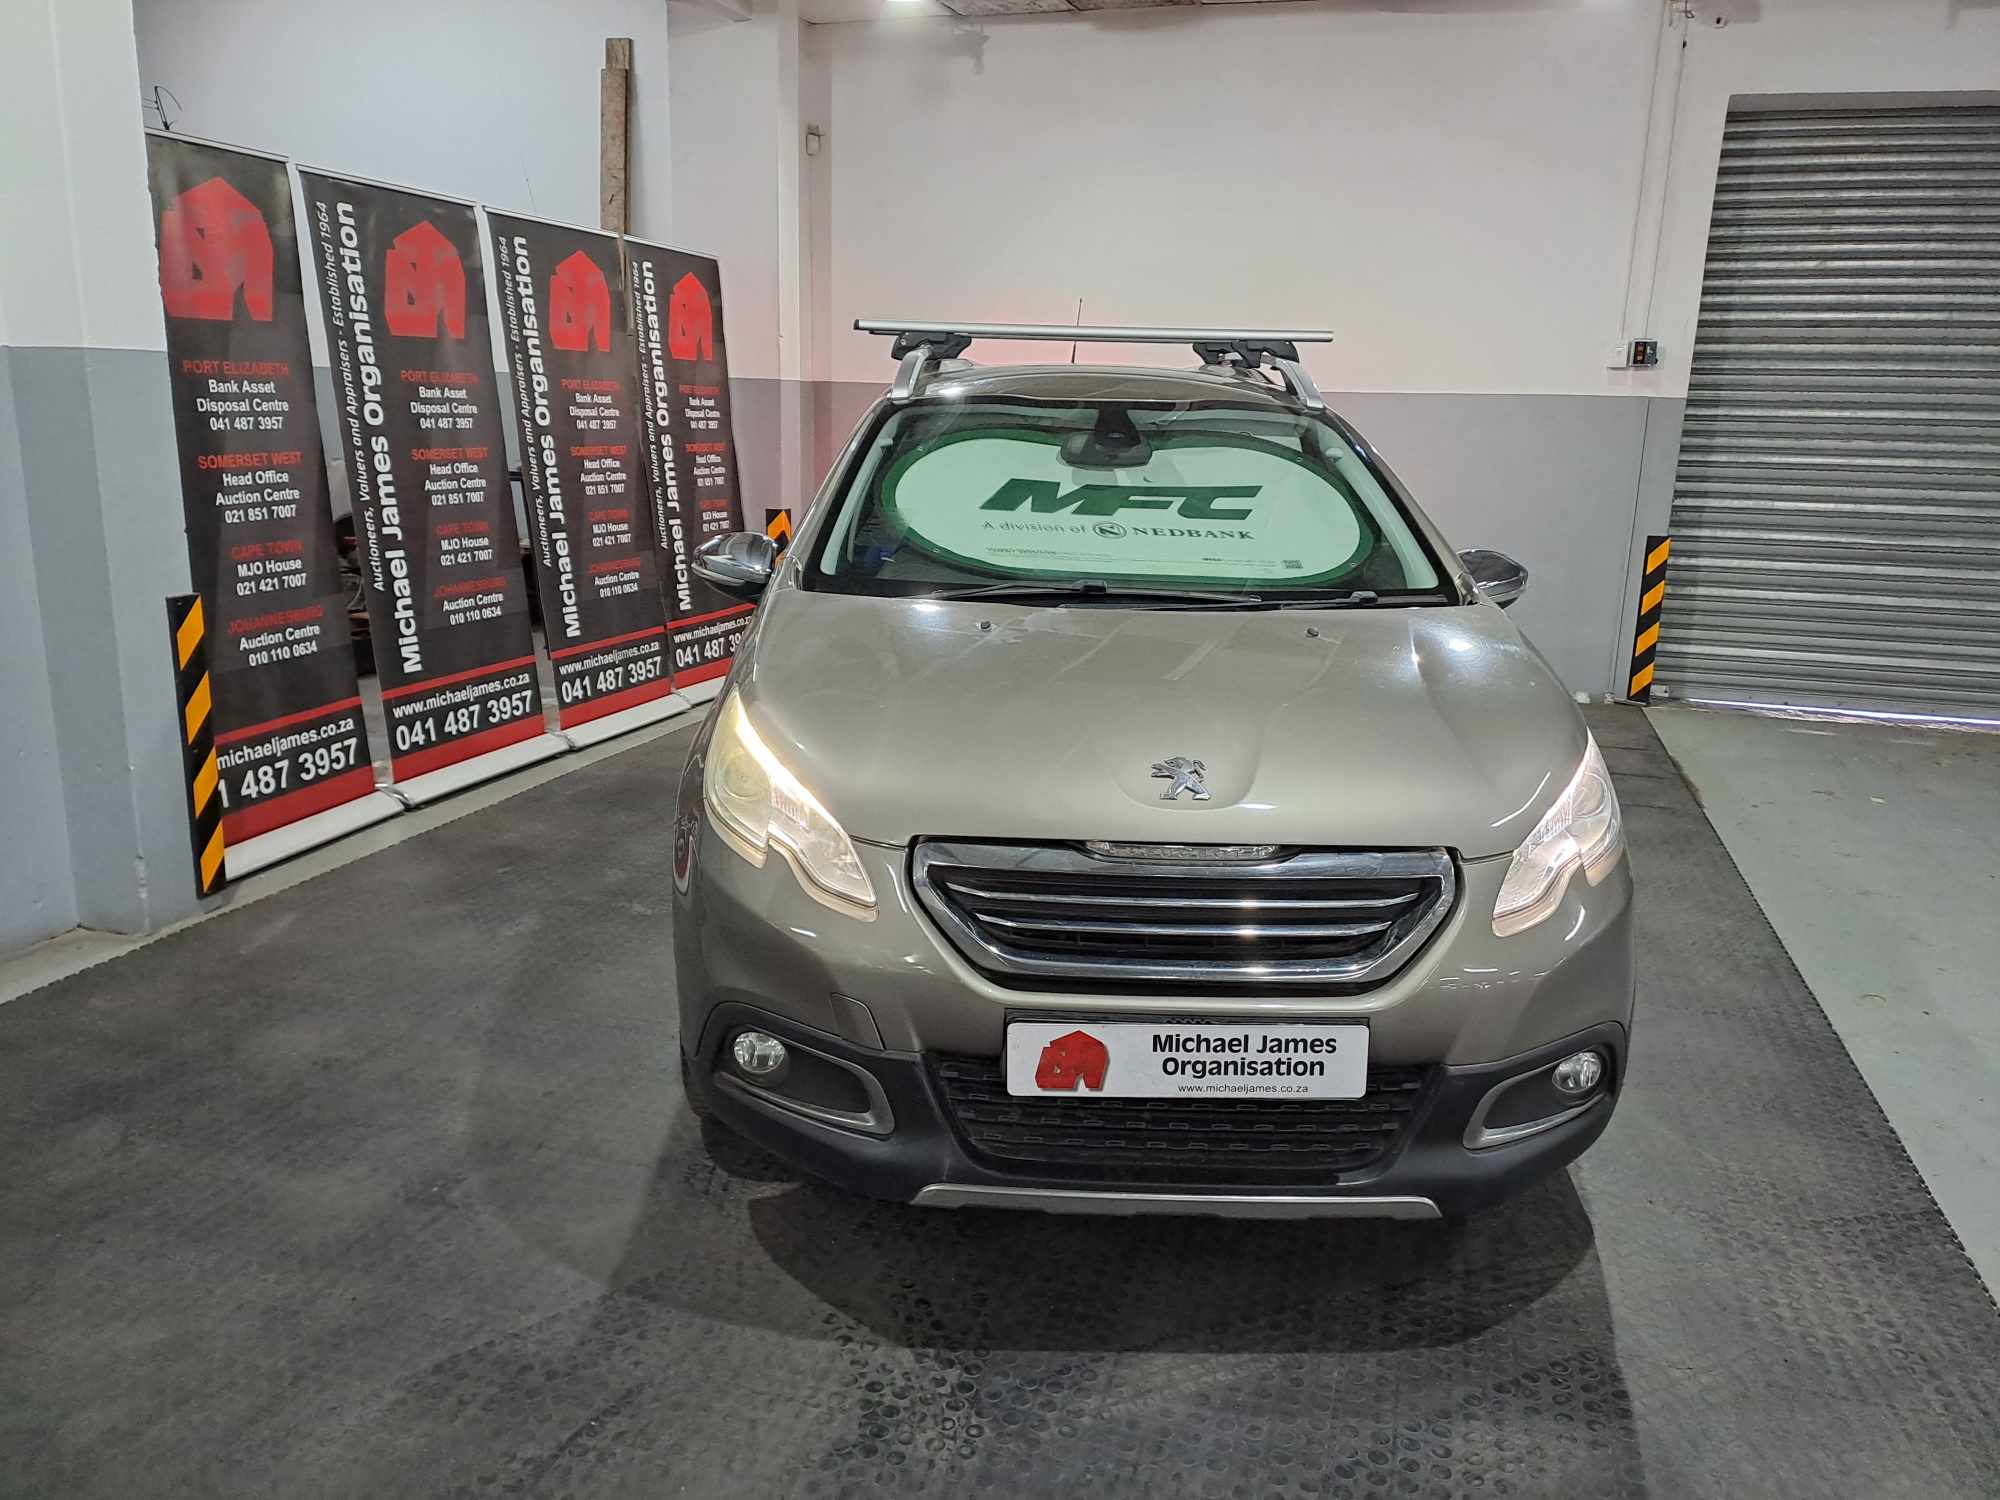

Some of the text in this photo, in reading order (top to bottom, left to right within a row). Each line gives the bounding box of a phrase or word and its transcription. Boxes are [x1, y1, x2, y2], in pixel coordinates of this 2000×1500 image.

[315, 201, 331, 239] 1964
[321, 243, 344, 327] Established
[502, 269, 520, 342] Established
[183, 360, 219, 374] PORT
[338, 338, 359, 416] Appraisers
[208, 379, 276, 394] Bank Asset
[419, 386, 467, 399] Bank Asset
[514, 352, 532, 417] Appraisers
[196, 398, 289, 414] Disposal Centre
[410, 402, 478, 415] Disposal Centre
[210, 417, 283, 430] 041 487 3957
[347, 417, 363, 445] and
[420, 418, 436, 429] 041
[522, 420, 533, 442] and
[337, 202, 423, 674] Michael James Organisation
[514, 236, 582, 638] Michael James Organisation
[642, 261, 692, 611] Michael James Organisation
[198, 452, 301, 469] SOMERSET WEST
[429, 462, 478, 475] Head Office
[528, 446, 542, 491] Valuers
[222, 470, 289, 486] Head Office
[354, 450, 371, 502] Valuers
[424, 478, 486, 491] Auction Centre
[215, 488, 300, 506] Auction Centre
[432, 491, 484, 506] 021 851 7007
[979, 478, 1264, 520] MFC
[224, 504, 297, 523] 021 851 7007
[607, 523, 629, 532] House
[982, 520, 994, 530] A
[999, 521, 1065, 533] division
[1070, 523, 1087, 534] of
[1132, 527, 1254, 540] NEDBANK
[363, 507, 385, 592] Auctioneers,
[441, 537, 489, 550] MJO House
[237, 559, 302, 577] MJO House
[440, 549, 493, 566] 021 421 7007
[236, 573, 307, 596] 021 421 7007
[594, 574, 618, 586] Auction
[443, 593, 504, 612] Auction Centre
[449, 606, 502, 626] 010 110 0634
[240, 624, 320, 651] Auction Centre
[249, 640, 318, 667] 010 110 0634
[559, 640, 660, 676] www.michaeljames.co.za
[676, 631, 744, 668] 041 487 39
[561, 656, 662, 704] 041 487 3957
[393, 672, 530, 719] www.michaeljames.co.za
[395, 689, 532, 751] 041 487 3957
[216, 718, 355, 770] michaeljames.co.za
[240, 759, 289, 799] 487
[297, 737, 358, 781] 3957
[1152, 1033, 1337, 1054] Michael James
[1161, 1056, 1326, 1079] Organisation
[1178, 1083, 1309, 1095] www.michaeljames.co.za
